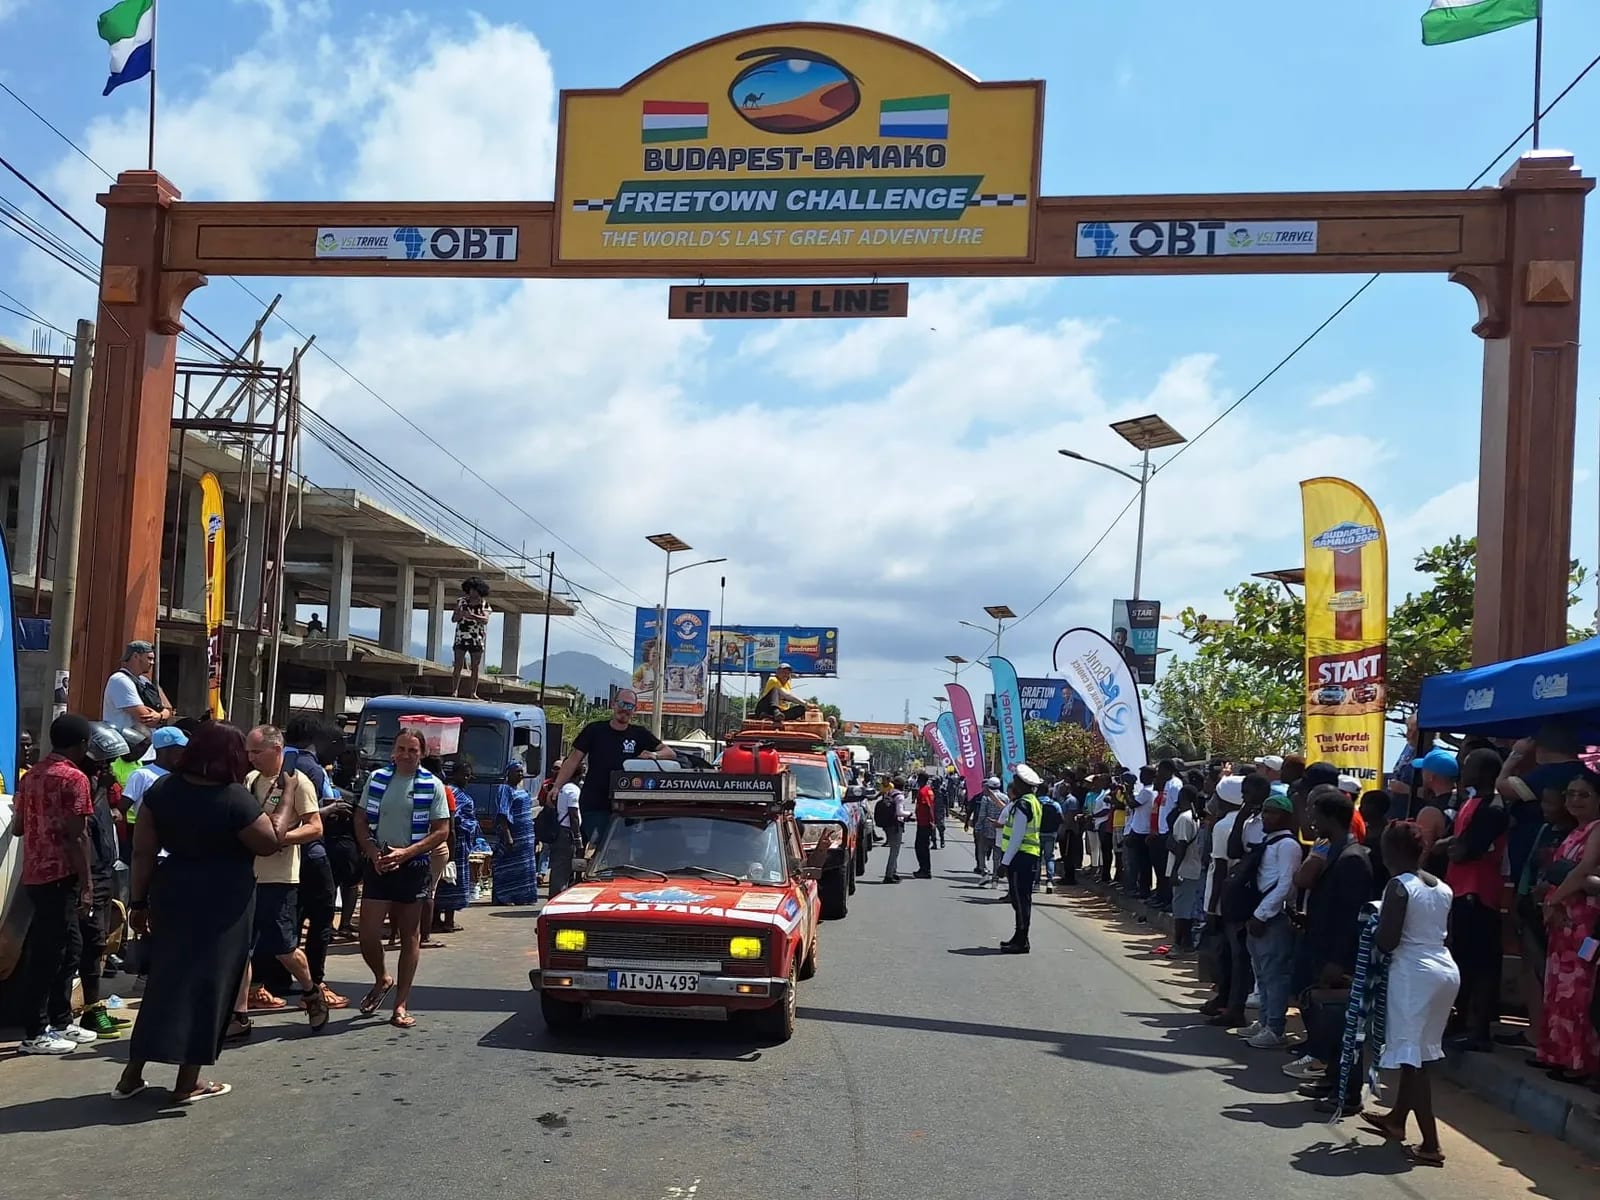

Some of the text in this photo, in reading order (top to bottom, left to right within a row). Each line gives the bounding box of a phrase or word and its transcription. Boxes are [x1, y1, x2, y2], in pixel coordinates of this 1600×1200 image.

[643, 144, 947, 171] BUDAPEST-BAMAKO
[617, 187, 968, 213] FREETOWN CHALLENGE
[430, 228, 513, 259] OBT
[602, 227, 984, 248] THE WORLD'S LAST GREAT ADVENTURE
[1129, 221, 1225, 256] OBT
[685, 289, 890, 313] FINISH LINE
[1322, 526, 1372, 539] BUDAPEST
[1318, 653, 1382, 684] START
[1021, 686, 1056, 698] GRAFTON
[1021, 698, 1049, 709] AMPION
[1314, 734, 1333, 743] The
[1320, 744, 1340, 753] Last
[660, 778, 773, 790] ZASTAVÁVAL AFRIKÁBA
